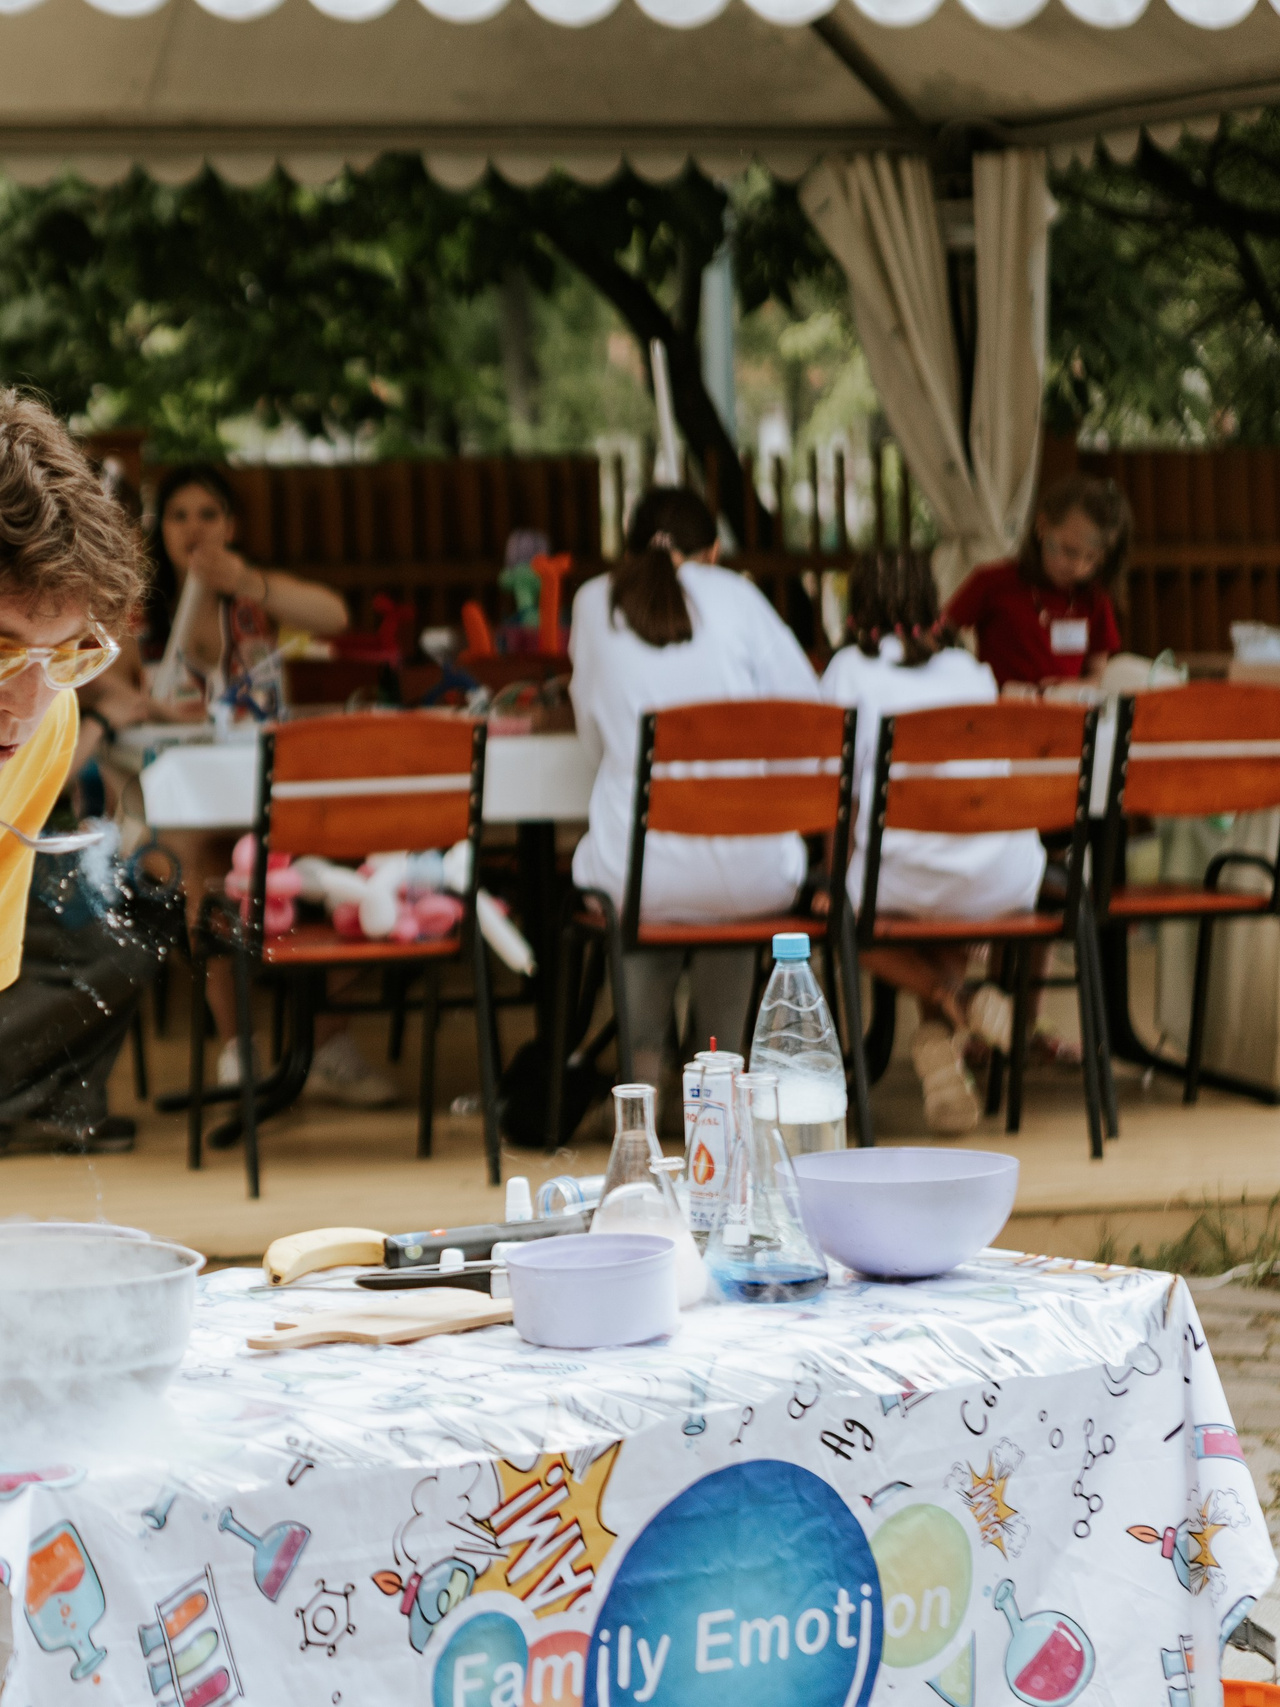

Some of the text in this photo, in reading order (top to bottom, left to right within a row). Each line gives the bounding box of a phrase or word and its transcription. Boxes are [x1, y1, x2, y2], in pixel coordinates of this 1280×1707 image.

[820, 1418, 875, 1462] Ag
[489, 1461, 597, 1614] AM!
[452, 1583, 951, 1707] Family Emotion
